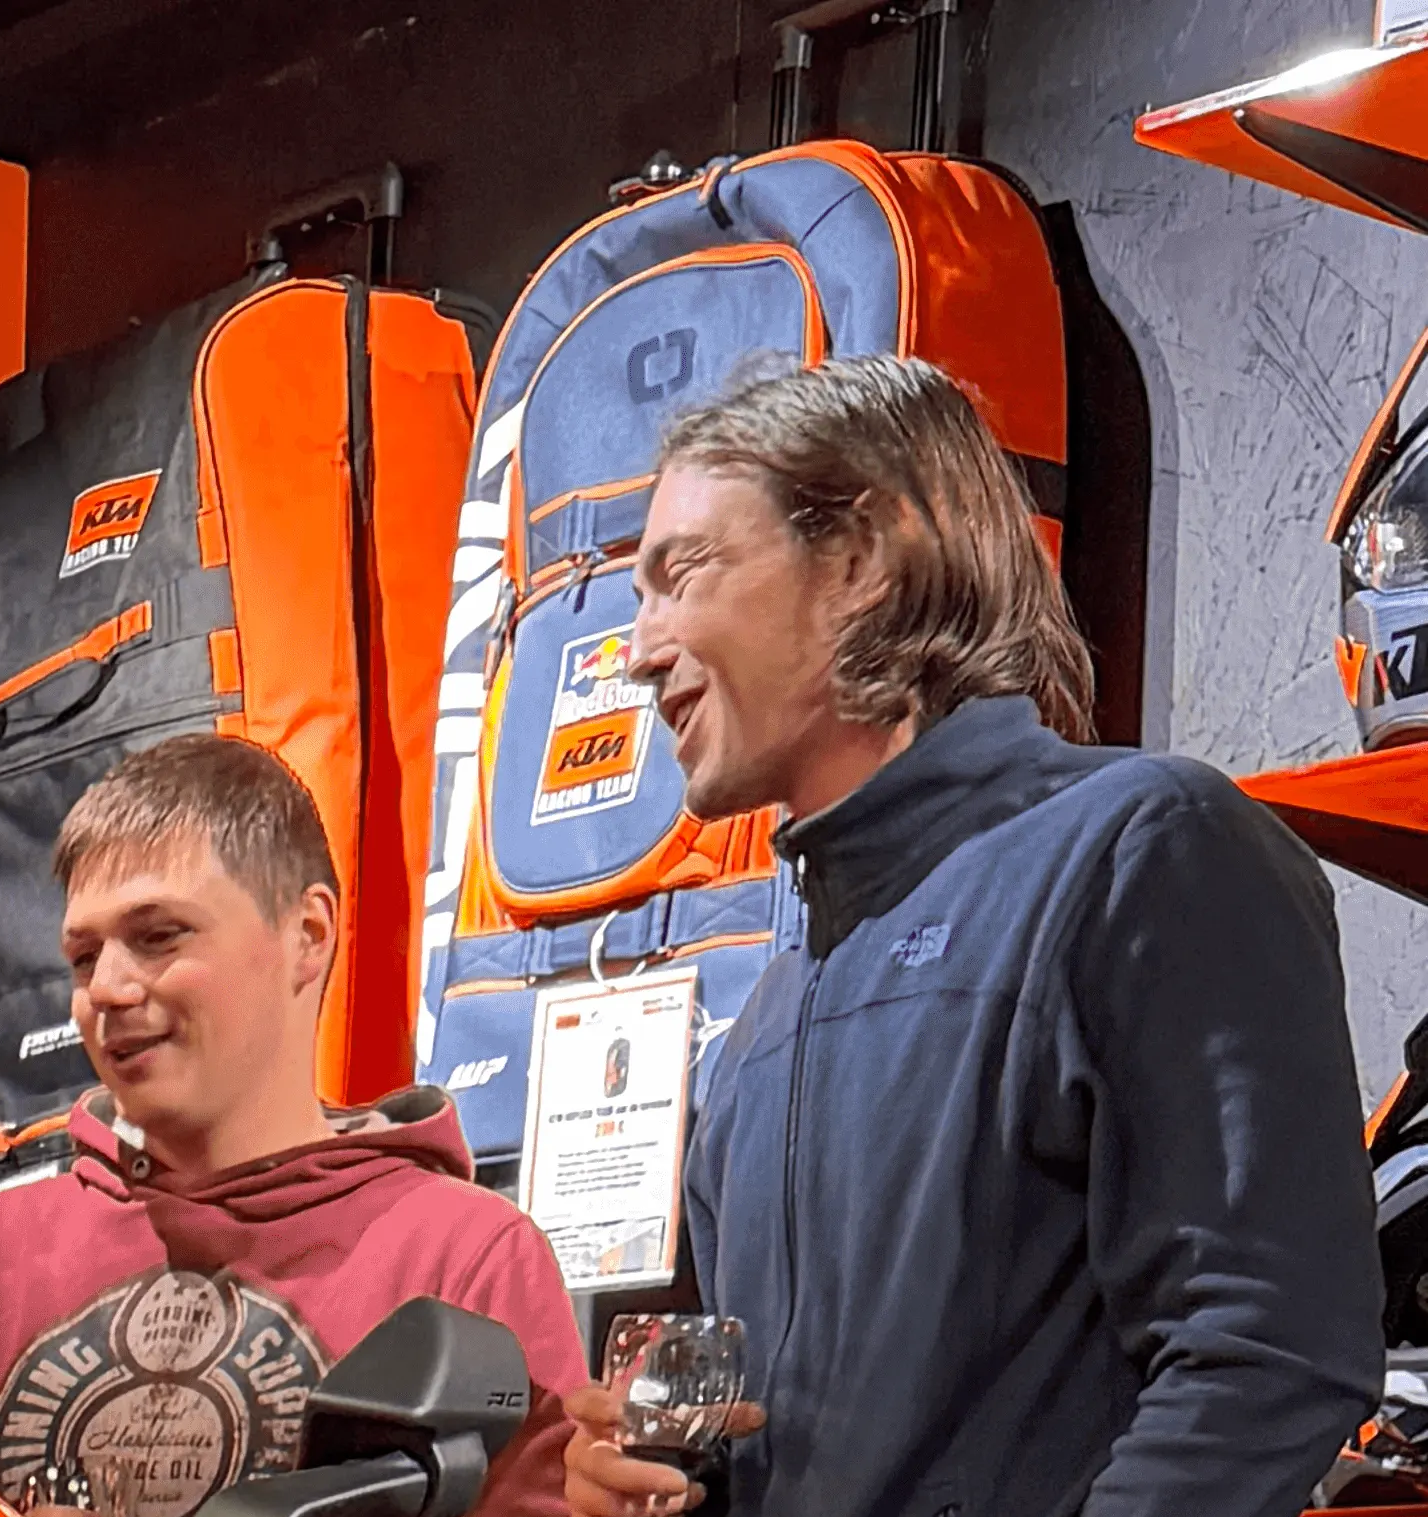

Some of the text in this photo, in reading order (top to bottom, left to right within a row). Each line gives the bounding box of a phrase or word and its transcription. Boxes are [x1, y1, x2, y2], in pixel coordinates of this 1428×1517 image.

[79, 494, 144, 536] KTM
[1373, 623, 1428, 708] KT
[557, 731, 628, 773] KTM
[170, 1459, 204, 1480] OIL
